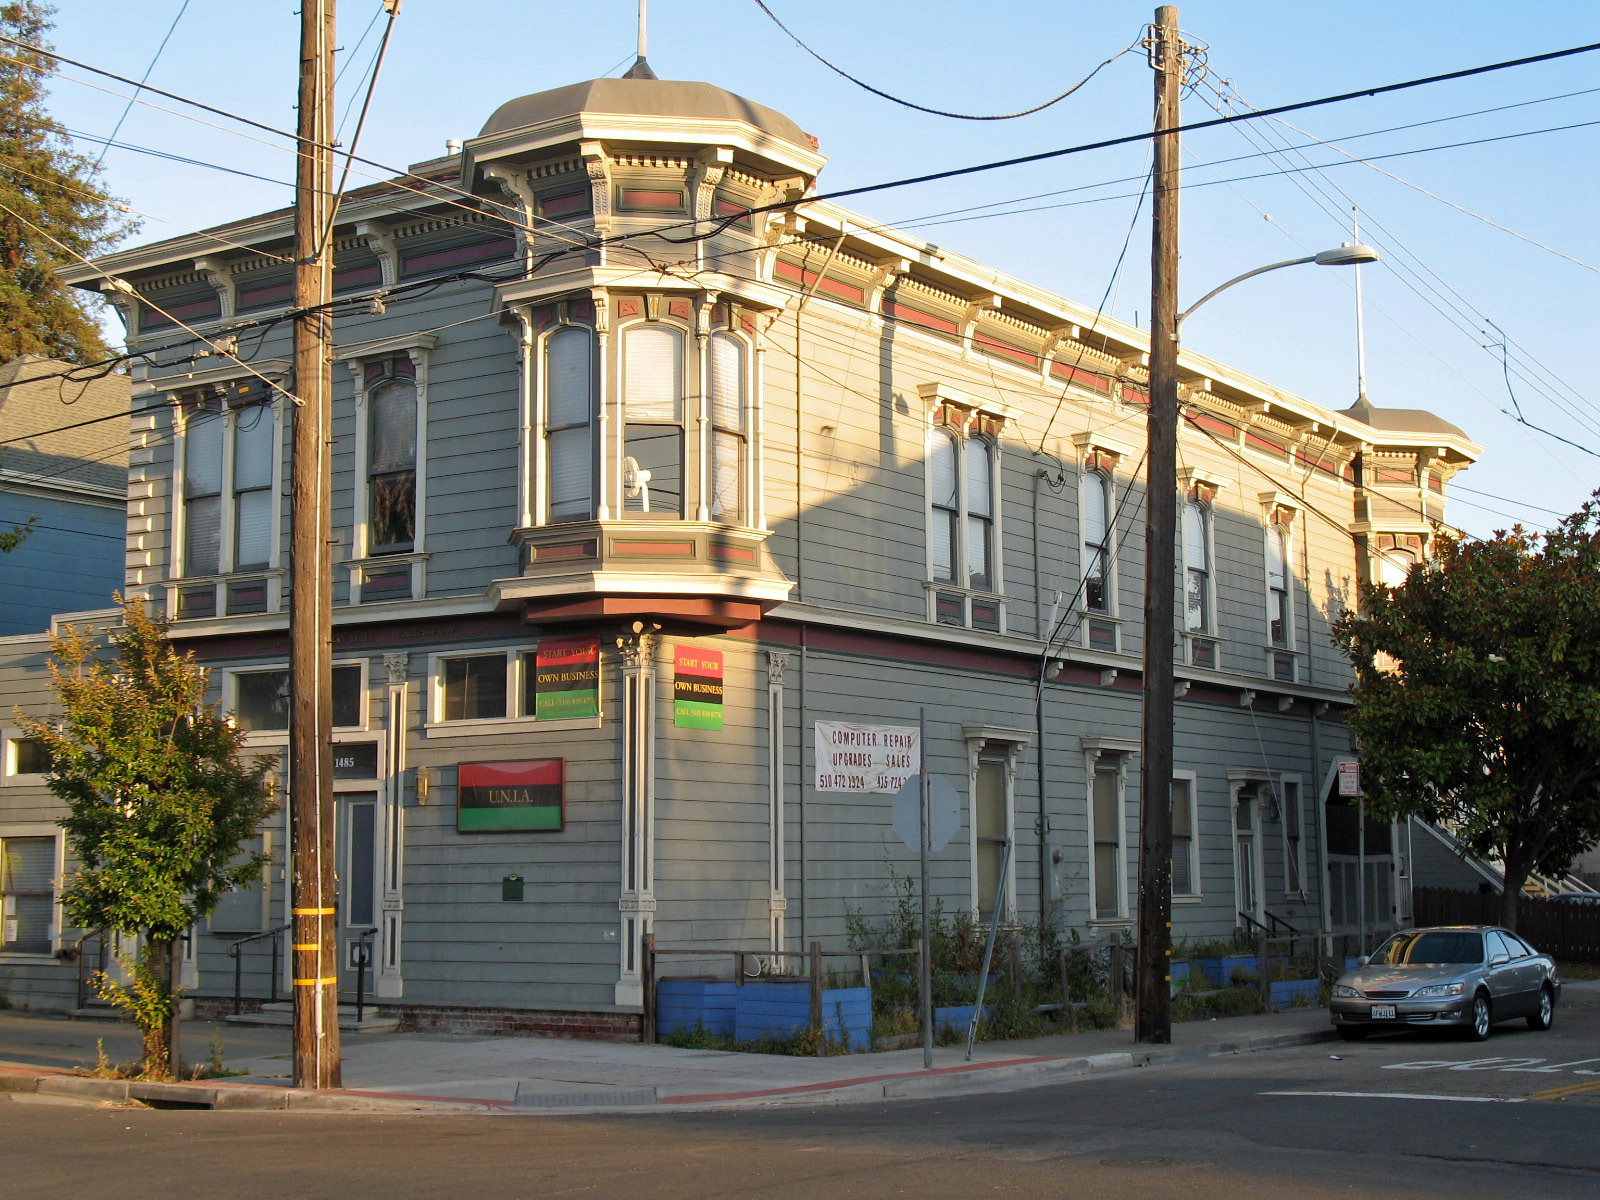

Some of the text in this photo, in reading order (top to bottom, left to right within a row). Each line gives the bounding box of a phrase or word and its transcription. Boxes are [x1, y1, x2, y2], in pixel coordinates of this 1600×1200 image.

[543, 647, 594, 659] START YOUR
[679, 657, 719, 671] START YOUR
[538, 670, 598, 683] OWN BUSINESS
[675, 681, 723, 695] OWN BUSINESS
[676, 707, 689, 716] CALL
[832, 730, 912, 748] COMPUTER REPAIR
[334, 757, 354, 768] 1485
[833, 752, 911, 768] UPGRADES SALES
[820, 774, 832, 788] 510
[834, 774, 846, 788] 472
[488, 789, 533, 804] U.N.I.A.
[1380, 1057, 1600, 1075] TOP
